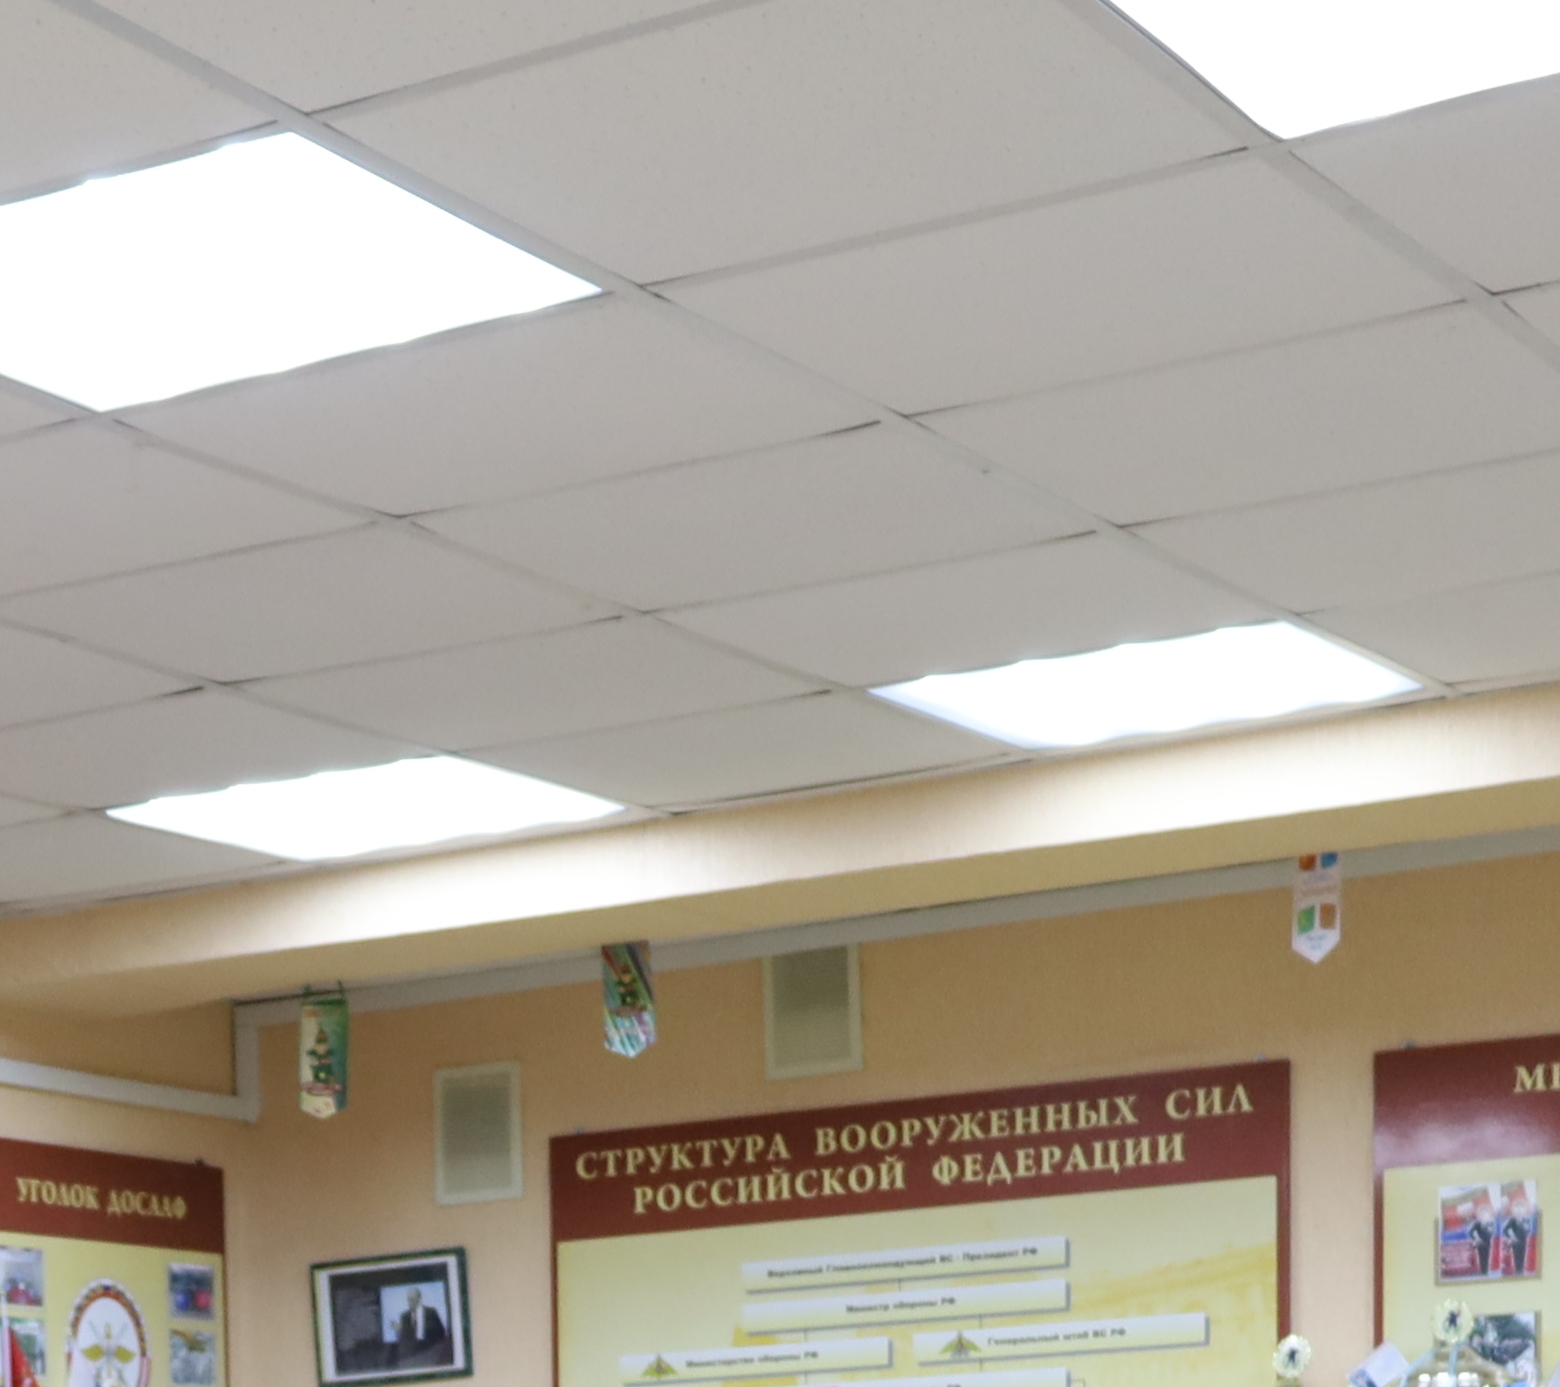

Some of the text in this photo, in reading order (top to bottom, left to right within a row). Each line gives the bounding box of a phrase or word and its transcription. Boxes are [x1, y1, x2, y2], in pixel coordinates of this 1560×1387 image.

[575, 1084, 1253, 1179] СТРУКТУРА ВООРУЖЕННЫХ СИЛ
[634, 1133, 1186, 1214] РОССИЙСКОЙ ФЕДЕРАЦИИ
[16, 1177, 187, 1219] УГОЛОК ДОСААФ
[1022, 1247, 1037, 1256] РФ
[941, 1296, 956, 1306] РФ
[1110, 1328, 1126, 1337] РФ
[804, 1351, 818, 1359] РФ
